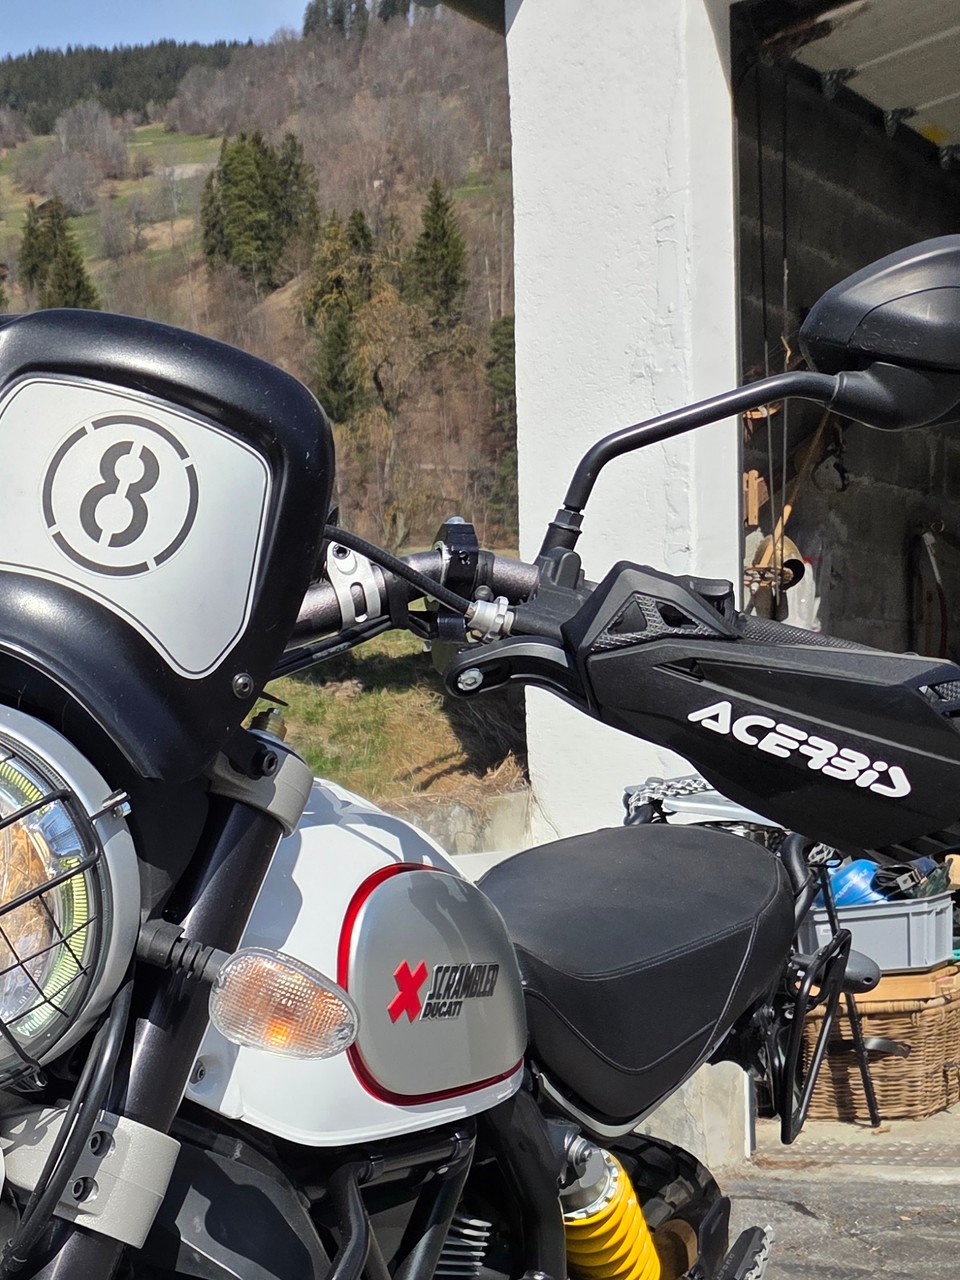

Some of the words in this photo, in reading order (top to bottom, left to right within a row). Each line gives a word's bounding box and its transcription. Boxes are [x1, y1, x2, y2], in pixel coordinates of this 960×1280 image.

[79, 440, 160, 548] 8
[687, 700, 911, 798] ACERBIS
[421, 1000, 463, 1019] DUCATI
[427, 963, 500, 1000] SCRAMBLER
